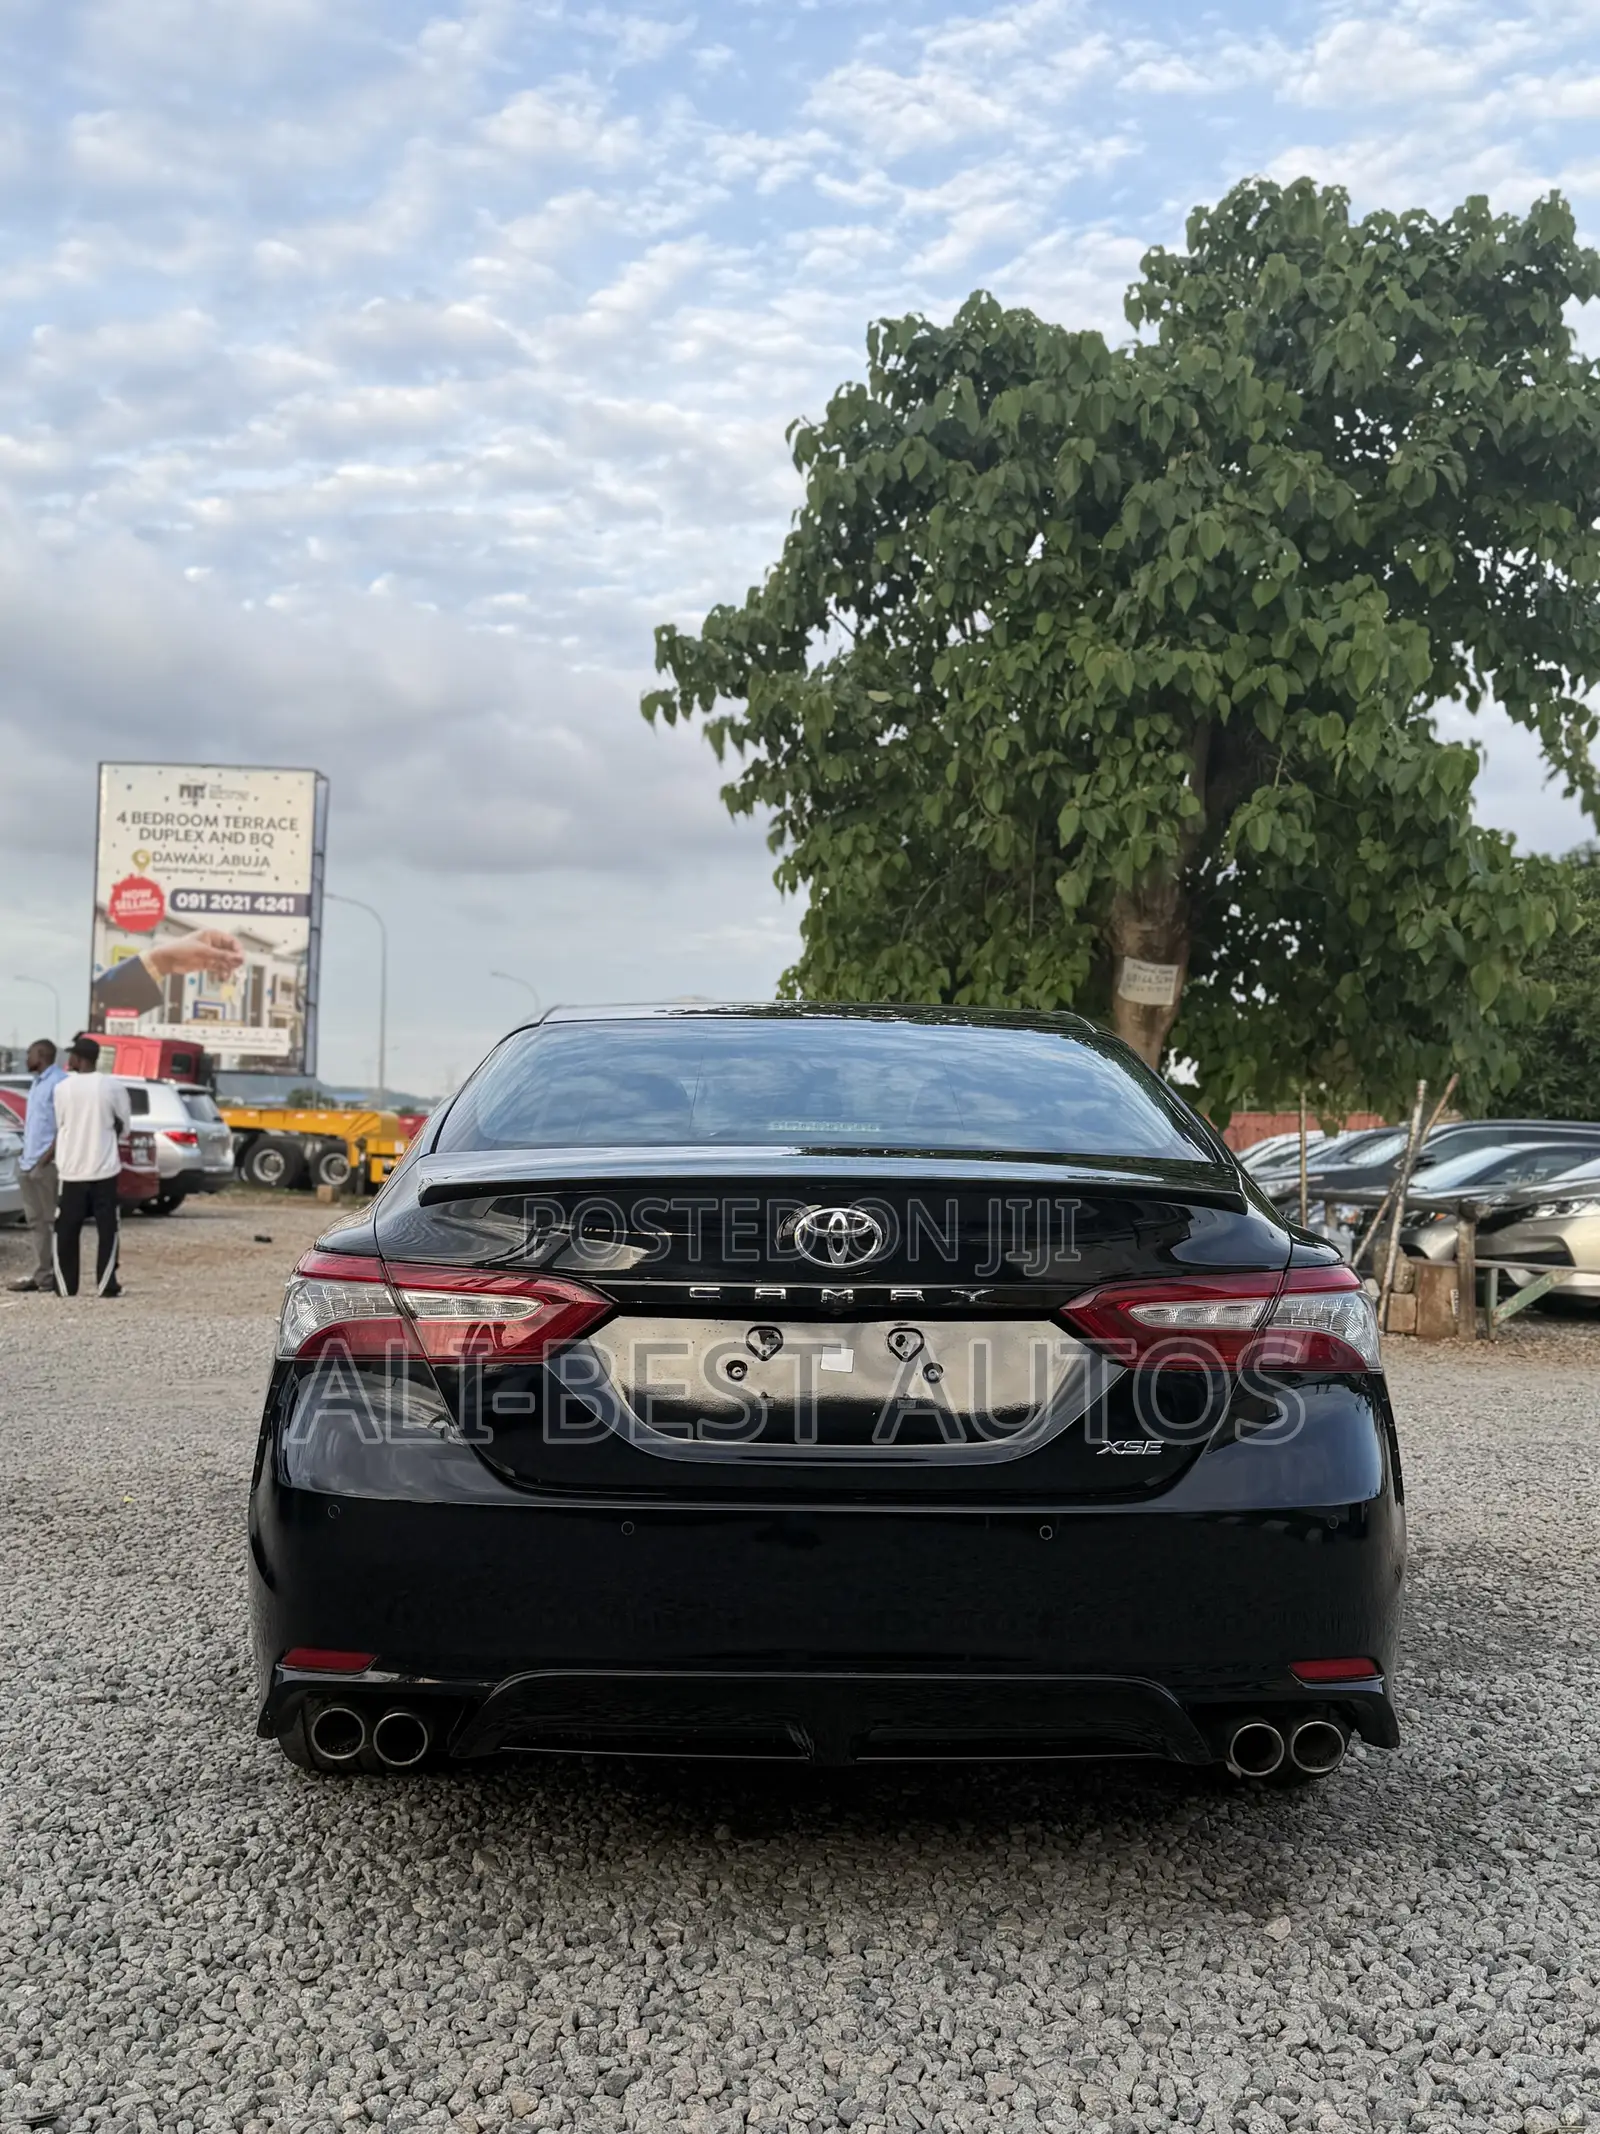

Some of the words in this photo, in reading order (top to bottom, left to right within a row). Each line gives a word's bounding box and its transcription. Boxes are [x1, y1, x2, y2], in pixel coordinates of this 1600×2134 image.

[117, 811, 127, 824] 4
[131, 811, 219, 828] BEDROOM
[223, 815, 299, 831] TERRACE
[139, 827, 205, 843] DUPLEX
[209, 831, 246, 845] AND
[250, 833, 274, 849] BQ
[152, 851, 214, 865] DAWAKI
[115, 897, 161, 911] SELLING
[176, 892, 206, 909] 091
[210, 894, 251, 911] 2021
[254, 896, 296, 913] 4241
[689, 1286, 995, 1303] CAMRY
[1096, 1440, 1165, 1455] XSE
